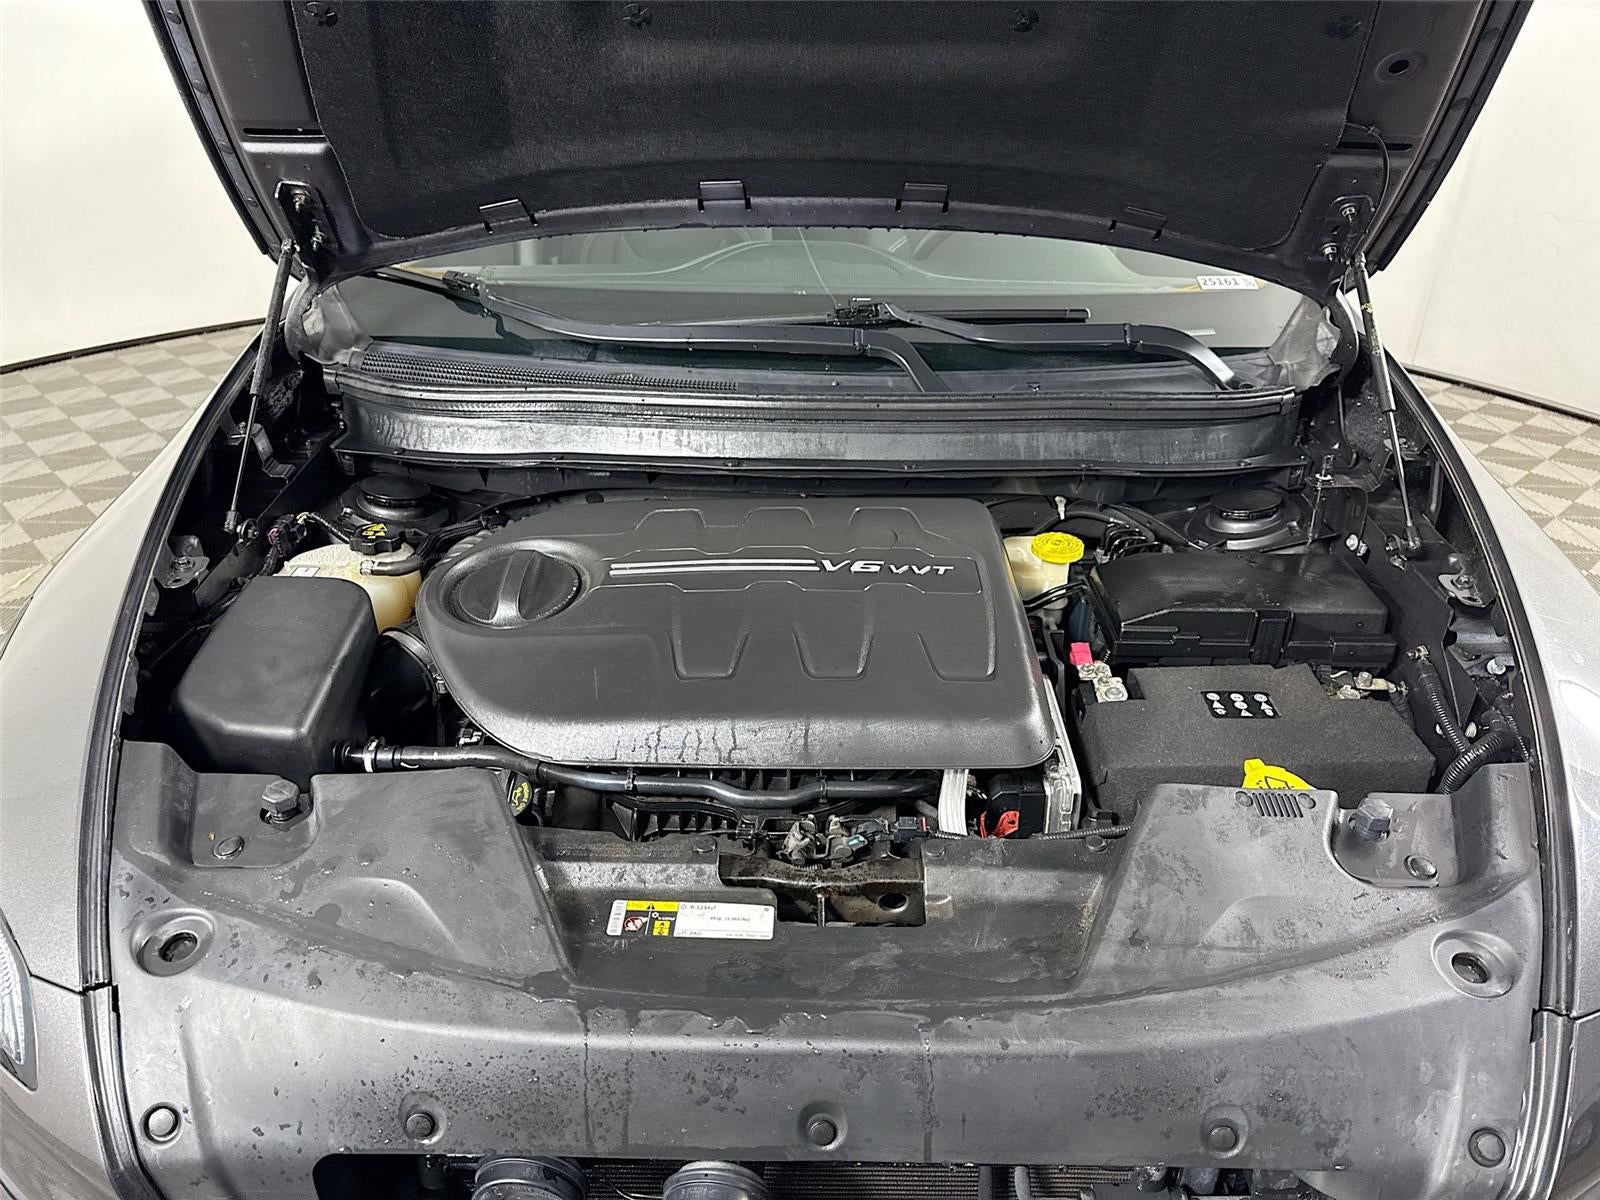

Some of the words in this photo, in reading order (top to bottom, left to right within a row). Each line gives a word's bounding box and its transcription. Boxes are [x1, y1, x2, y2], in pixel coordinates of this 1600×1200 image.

[821, 559, 885, 574] V6
[889, 564, 955, 575] VVT
[515, 802, 526, 812] OIL
